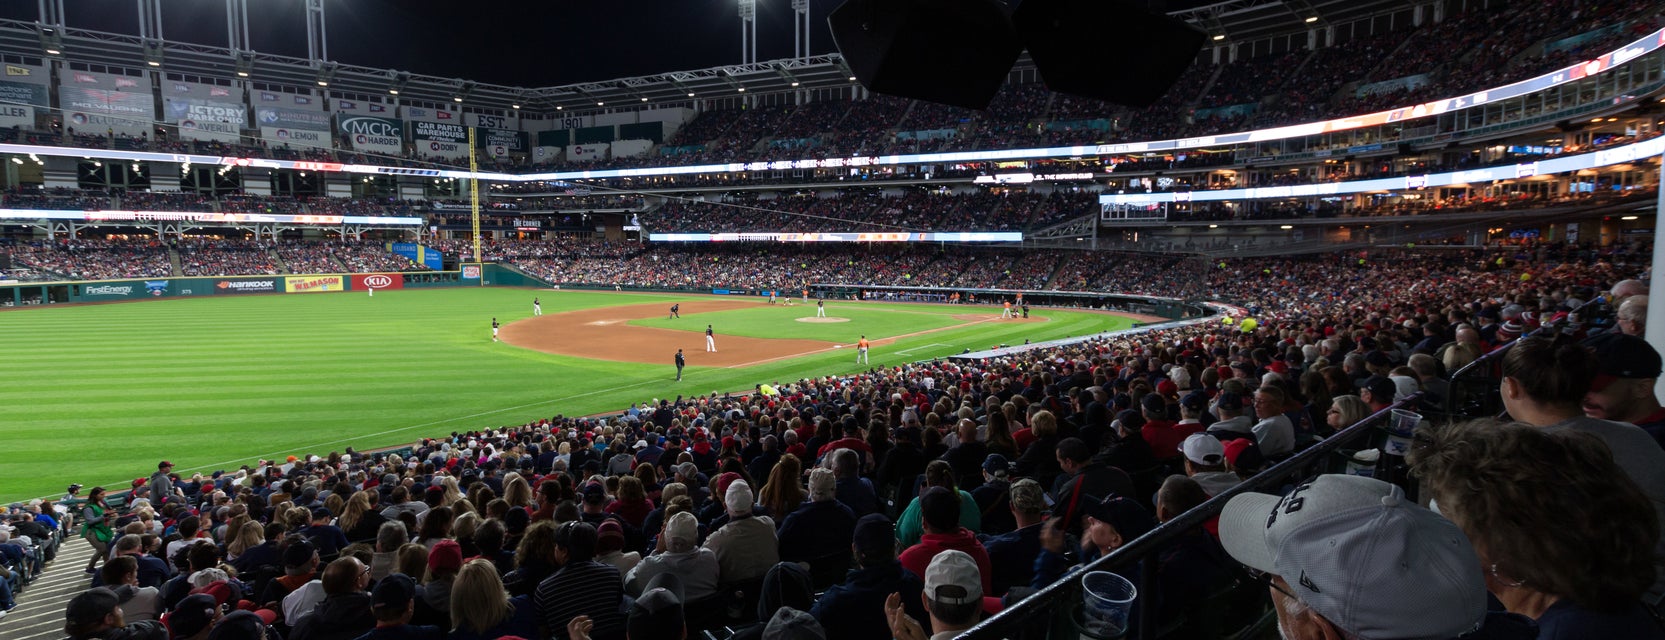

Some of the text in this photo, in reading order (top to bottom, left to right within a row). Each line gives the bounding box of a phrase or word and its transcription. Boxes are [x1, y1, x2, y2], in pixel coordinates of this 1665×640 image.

[187, 113, 216, 122] PARK
[478, 115, 508, 129] EST.
[198, 122, 236, 133] AVERILL
[418, 122, 464, 133] CAR PARTS
[561, 118, 583, 129] 1901
[290, 132, 319, 141] LEMON
[416, 128, 466, 139] WAREHOUSE
[368, 136, 399, 146] HARDER
[440, 143, 458, 152] DOBY
[513, 219, 522, 227] THE
[368, 277, 387, 285] KIA
[86, 285, 133, 294] FirstEnergy
